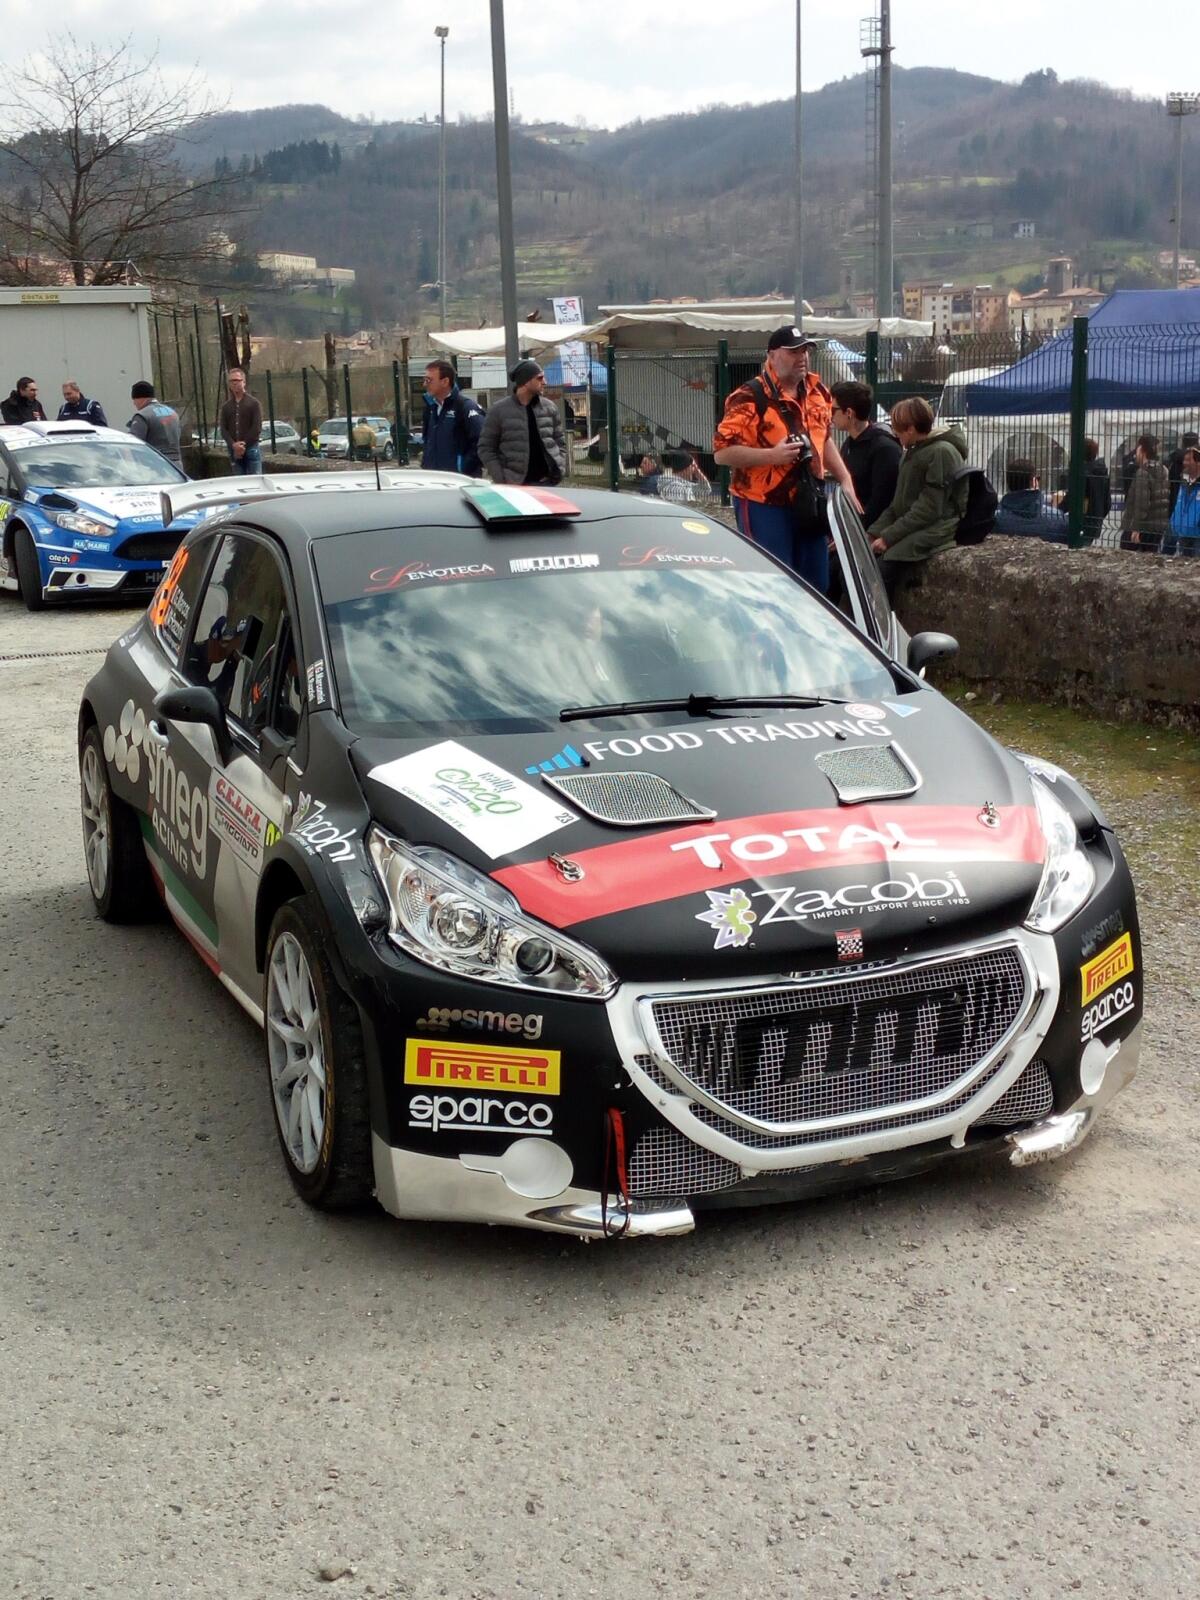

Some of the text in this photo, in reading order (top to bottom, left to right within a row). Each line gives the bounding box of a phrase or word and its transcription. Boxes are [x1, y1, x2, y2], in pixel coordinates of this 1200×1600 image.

[583, 718, 892, 761] FOOD TRADING
[147, 744, 208, 880] smeg
[555, 811, 575, 825] 23
[670, 821, 938, 870] TOTAL
[751, 871, 967, 927] Zacobi
[812, 907, 855, 920] IMPORT
[868, 901, 908, 913] EXPORT
[912, 900, 945, 908] SINCE
[1086, 942, 1128, 998] PIRELLI
[462, 1009, 544, 1041] smeg
[1081, 981, 1134, 1040] sparco
[416, 1047, 550, 1087] PIRELLI
[408, 1094, 553, 1134] sparco
